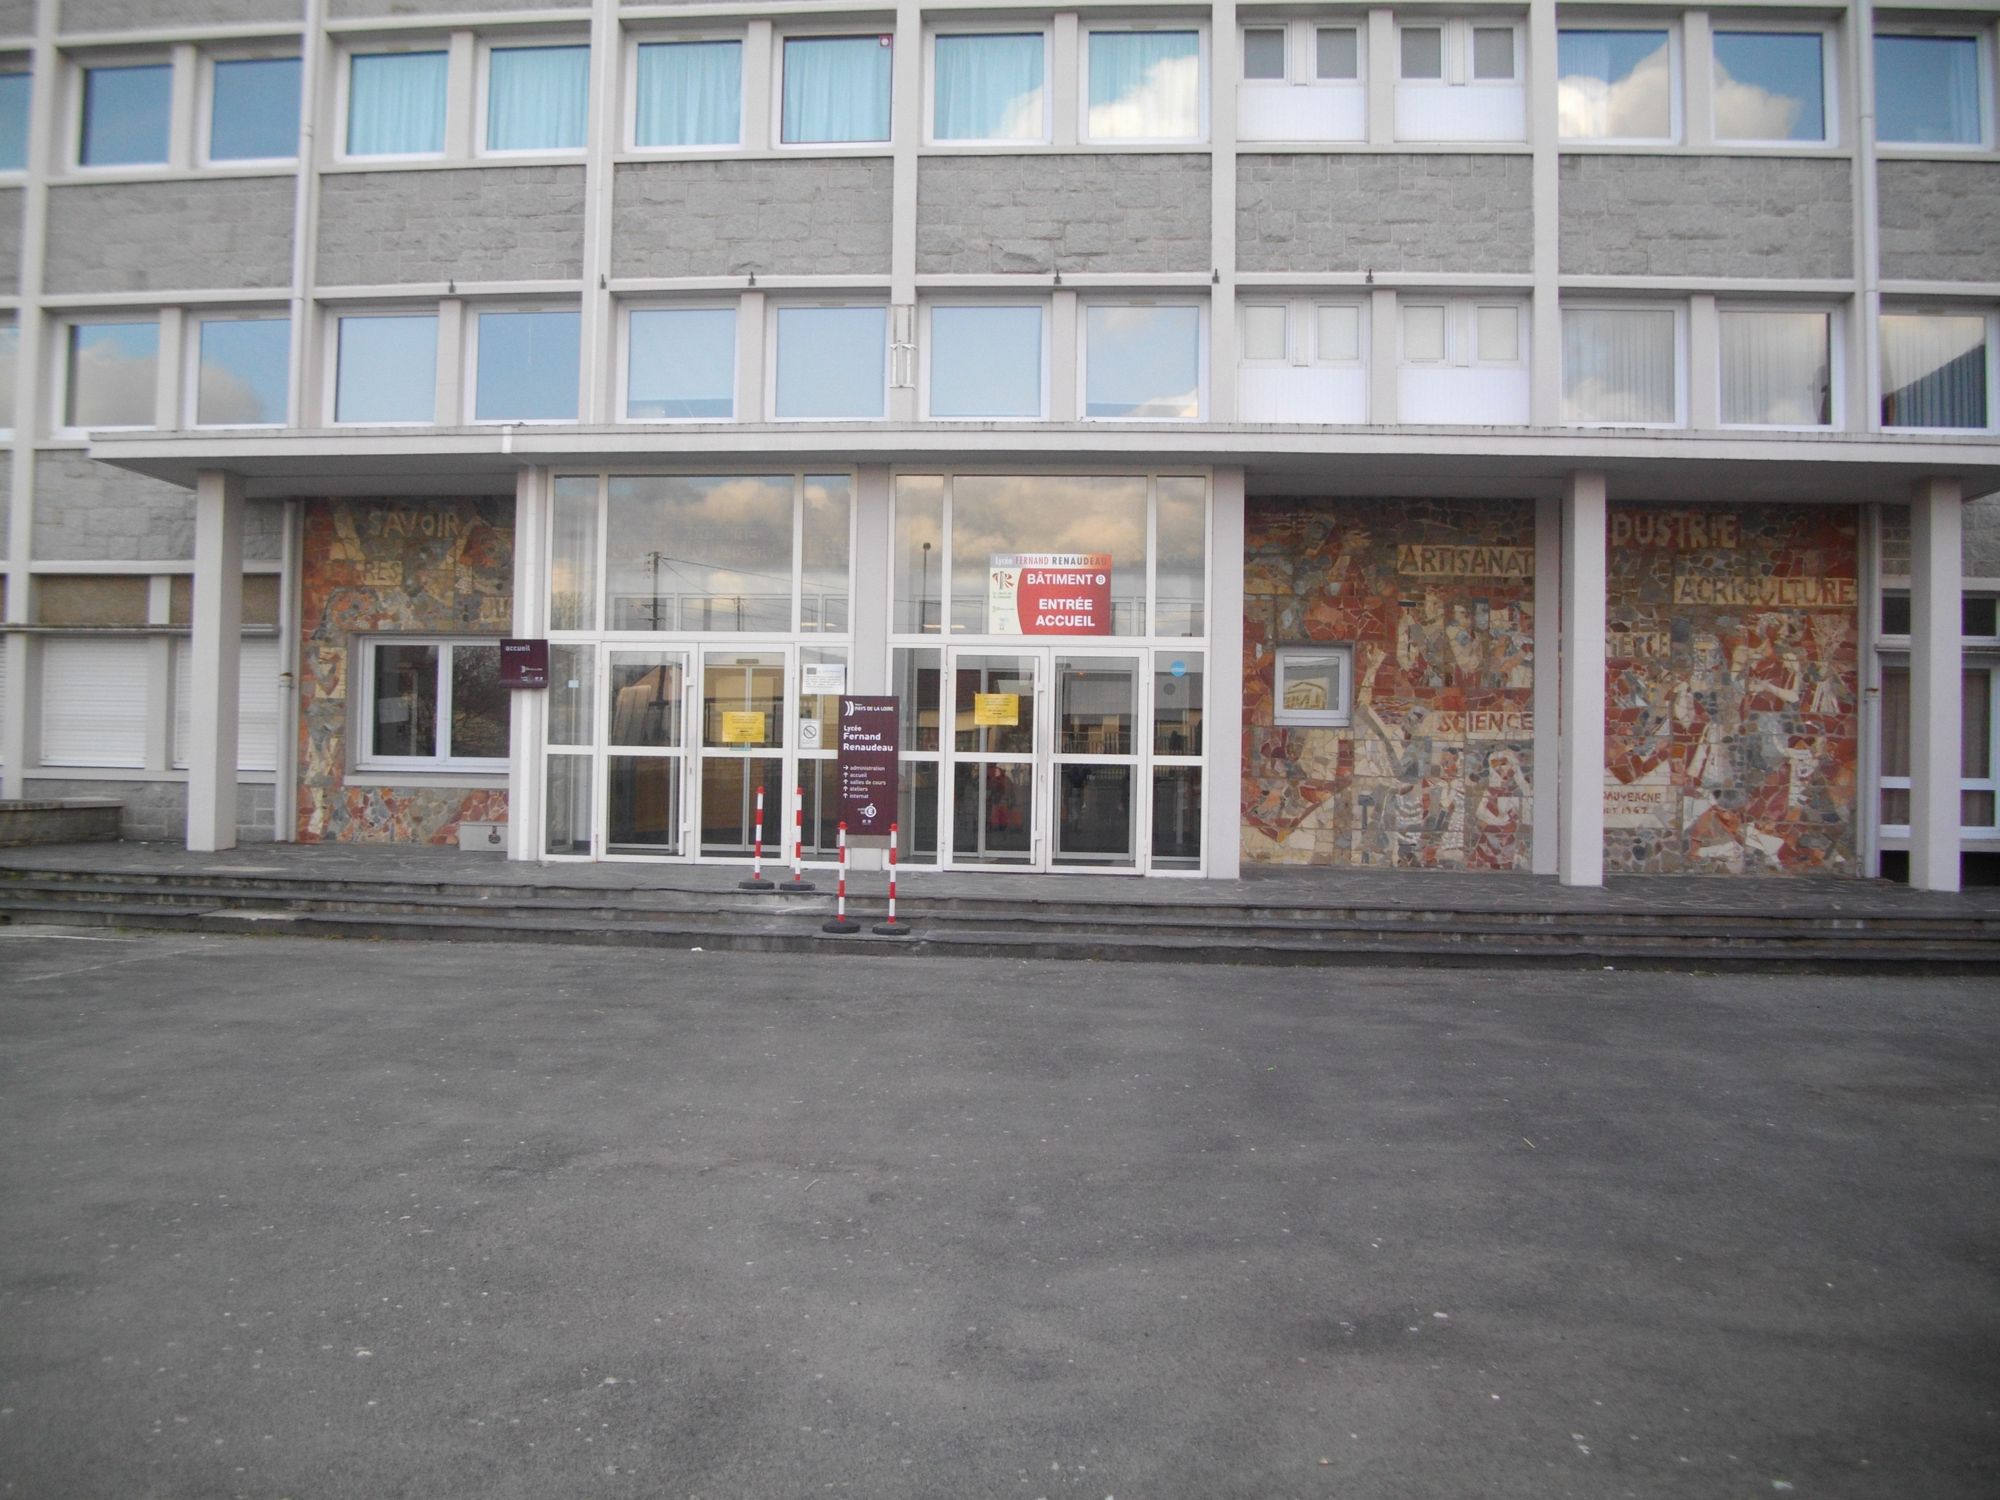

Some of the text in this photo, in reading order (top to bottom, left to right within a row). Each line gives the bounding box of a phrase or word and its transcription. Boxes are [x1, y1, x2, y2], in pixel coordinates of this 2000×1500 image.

[368, 511, 459, 538] SAVOIR
[1611, 512, 1737, 548] DUSTRIE
[1015, 556, 1049, 565] FERNAND
[1052, 556, 1107, 565] RENAUDEAU
[1399, 544, 1534, 575] ARTISANAT
[1027, 571, 1093, 585] BÂTIMENT
[1039, 596, 1093, 610] ENTRÉE
[1035, 615, 1096, 627] ACCUEIL
[505, 644, 531, 652] accueil
[843, 732, 881, 740] Fernand
[843, 743, 893, 751] Renaudeau
